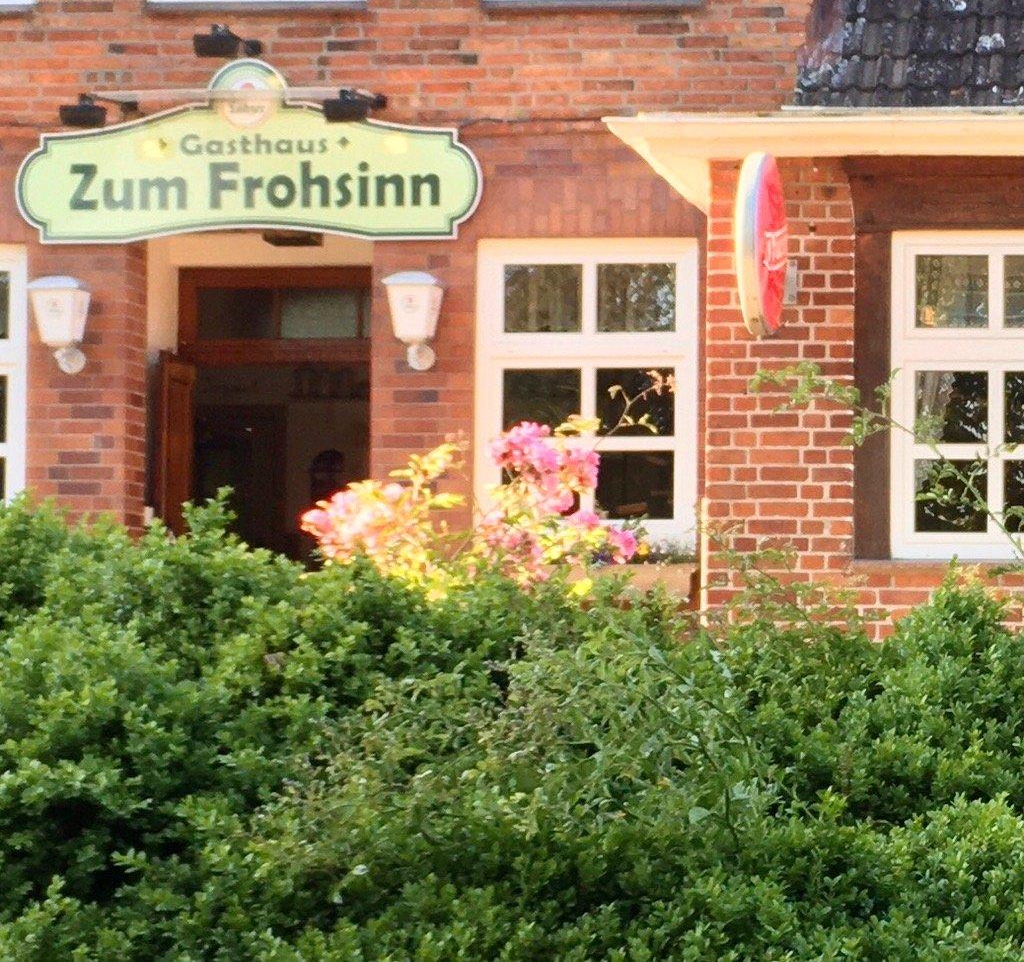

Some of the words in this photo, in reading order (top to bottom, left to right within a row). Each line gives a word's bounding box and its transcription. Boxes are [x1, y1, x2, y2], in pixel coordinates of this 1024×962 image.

[180, 134, 329, 156] Gasthaus
[69, 163, 188, 210] Zum
[208, 160, 441, 209] Frohsinn
